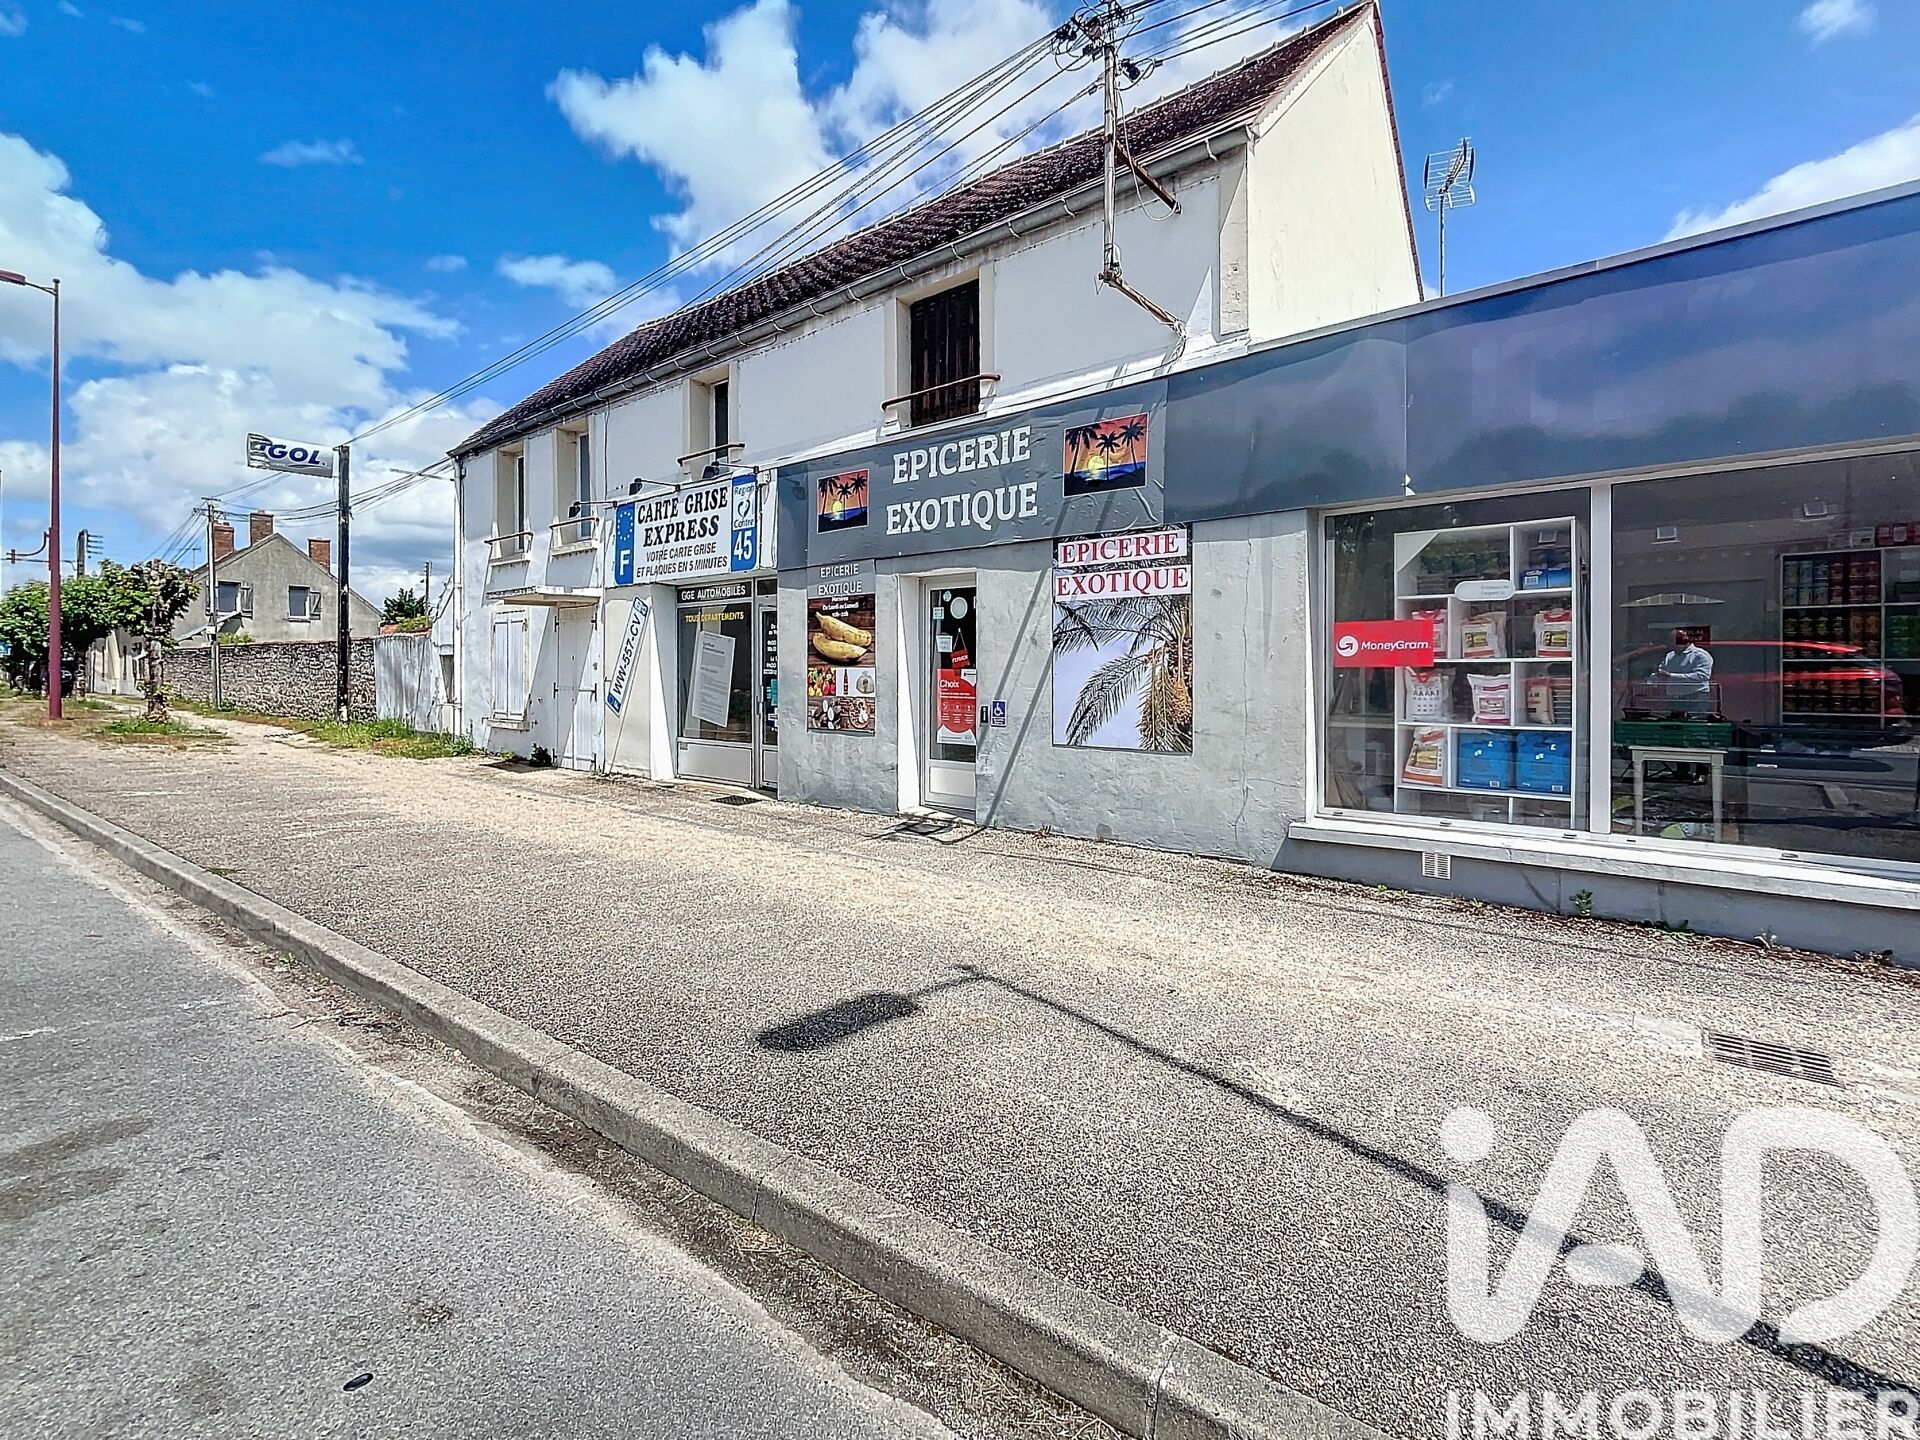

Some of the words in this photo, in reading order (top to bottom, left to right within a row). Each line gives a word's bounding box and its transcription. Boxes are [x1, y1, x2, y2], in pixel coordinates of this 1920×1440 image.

[892, 425, 1031, 484] EPICERIE
[637, 497, 679, 524] CARTE
[684, 486, 728, 514] GRISE
[886, 482, 1038, 536] EXOTIQUE
[643, 514, 720, 547] EXPRESS
[733, 518, 754, 529] Centre
[646, 549, 668, 562] VOTRE
[669, 546, 693, 559] CARTE
[693, 542, 717, 555] GRISE
[733, 530, 753, 561] 45
[1061, 532, 1180, 564] EPICERIE
[620, 549, 631, 576] F
[636, 567, 644, 578] ET
[645, 562, 676, 576] PLAQUES
[678, 561, 687, 572] EN
[689, 560, 694, 572] 5
[694, 556, 728, 571] MINUTES
[820, 563, 860, 578] EPICERIE
[697, 585, 746, 600] AUTOMOBILES
[818, 580, 863, 596] EXOTIQUE
[1056, 567, 1189, 597] EXOTIQUE
[685, 614, 700, 623] TOUS
[612, 613, 641, 695] WW-557-CV
[1361, 640, 1429, 652] MoneyGram
[939, 679, 960, 689] Choix
